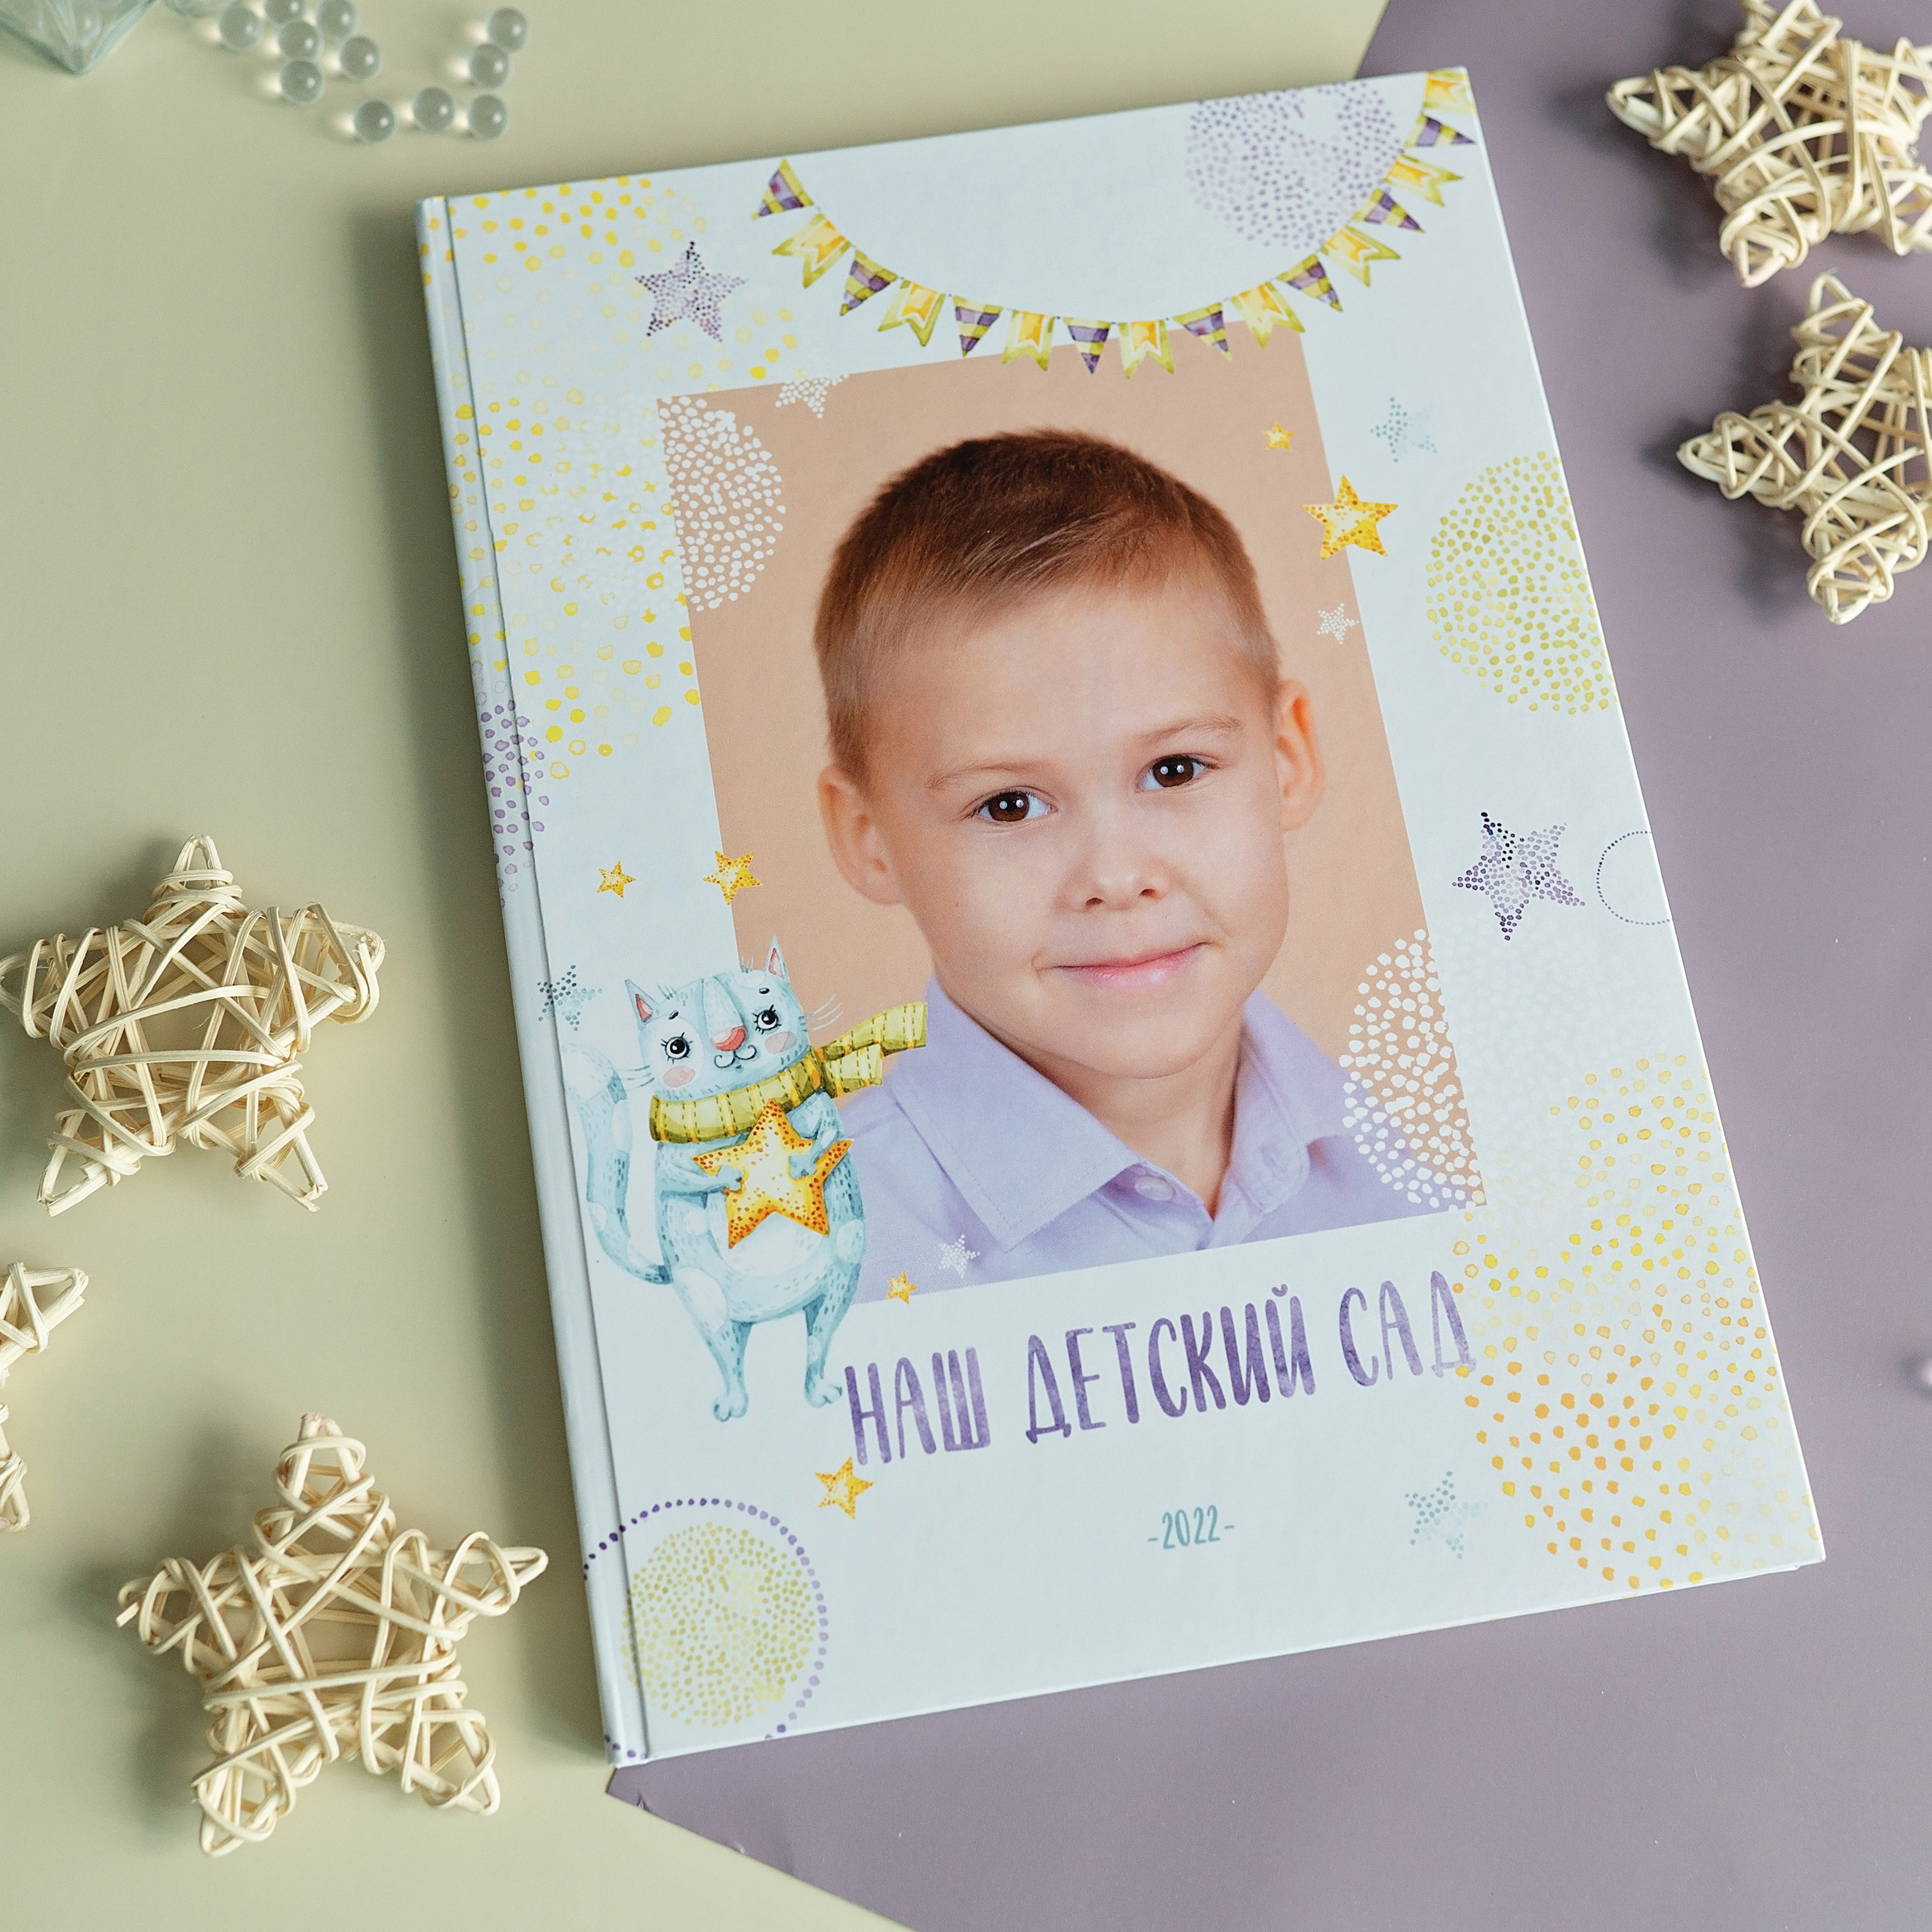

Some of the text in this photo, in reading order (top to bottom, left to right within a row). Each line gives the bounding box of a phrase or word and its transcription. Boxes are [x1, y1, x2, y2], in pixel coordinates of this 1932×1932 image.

[844, 1270, 1477, 1466] НАШ ДЕТСКИЙ САД
[1147, 1505, 1235, 1550] -2022-
